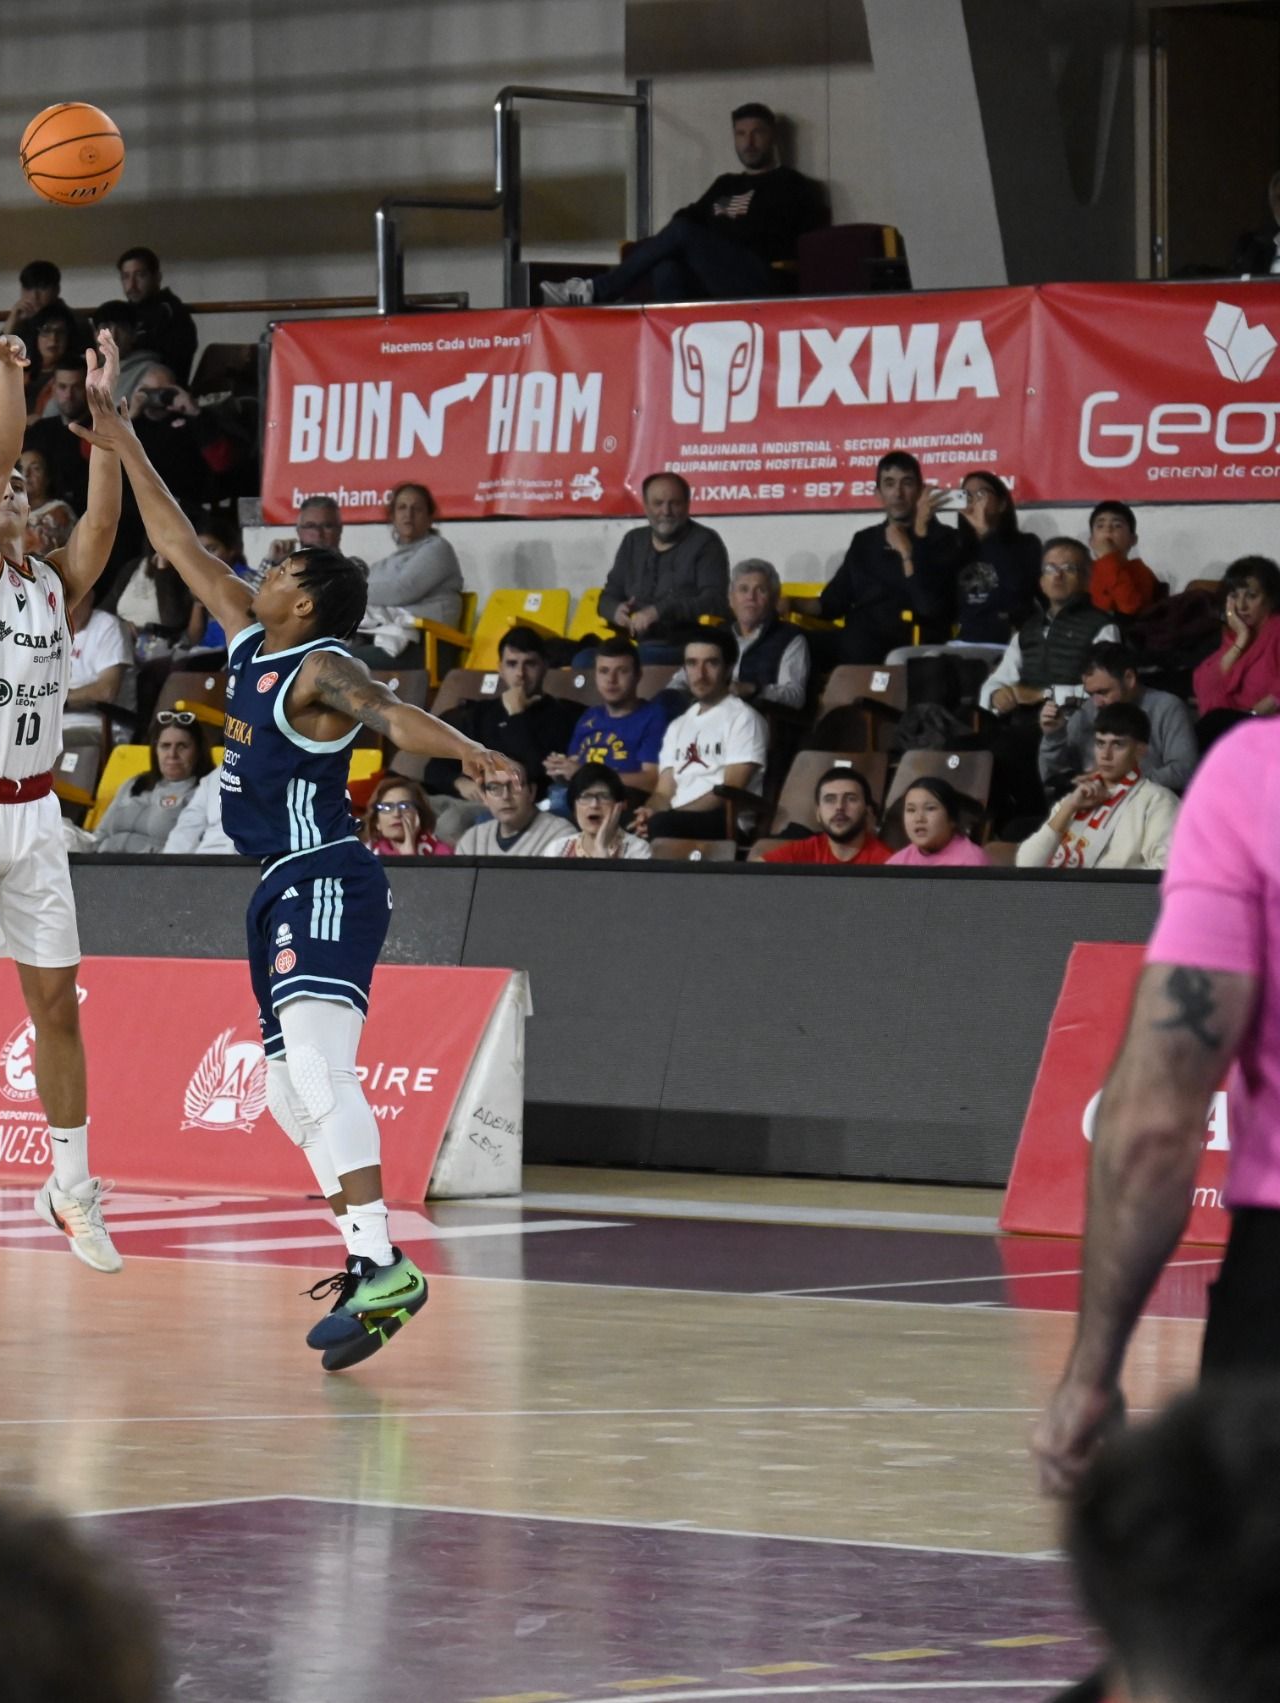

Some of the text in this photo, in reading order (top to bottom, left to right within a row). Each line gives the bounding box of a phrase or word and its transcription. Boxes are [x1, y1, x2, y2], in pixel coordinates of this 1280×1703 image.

[381, 341, 434, 354] Hacemos
[436, 338, 465, 351] Cada
[468, 337, 490, 349] Una
[494, 335, 520, 347] Para
[777, 320, 1000, 408] IXMA
[289, 381, 392, 463] BUN
[487, 371, 603, 455] HAM
[1079, 390, 1280, 468] Geo
[681, 431, 983, 456] MAQUINARIA INDUSTRIAL SECTOR ALIMENTACIÓN
[664, 459, 761, 473] EQUIPAMIENTOS
[765, 454, 838, 471] HOSTELERÍA
[922, 450, 998, 464] INTEGRALES
[1147, 463, 1218, 481] general
[1223, 463, 1246, 477] de
[804, 482, 845, 498] 987
[13, 633, 48, 648] CAJA
[15, 712, 41, 746] 10
[355, 1062, 439, 1096] PIRE
